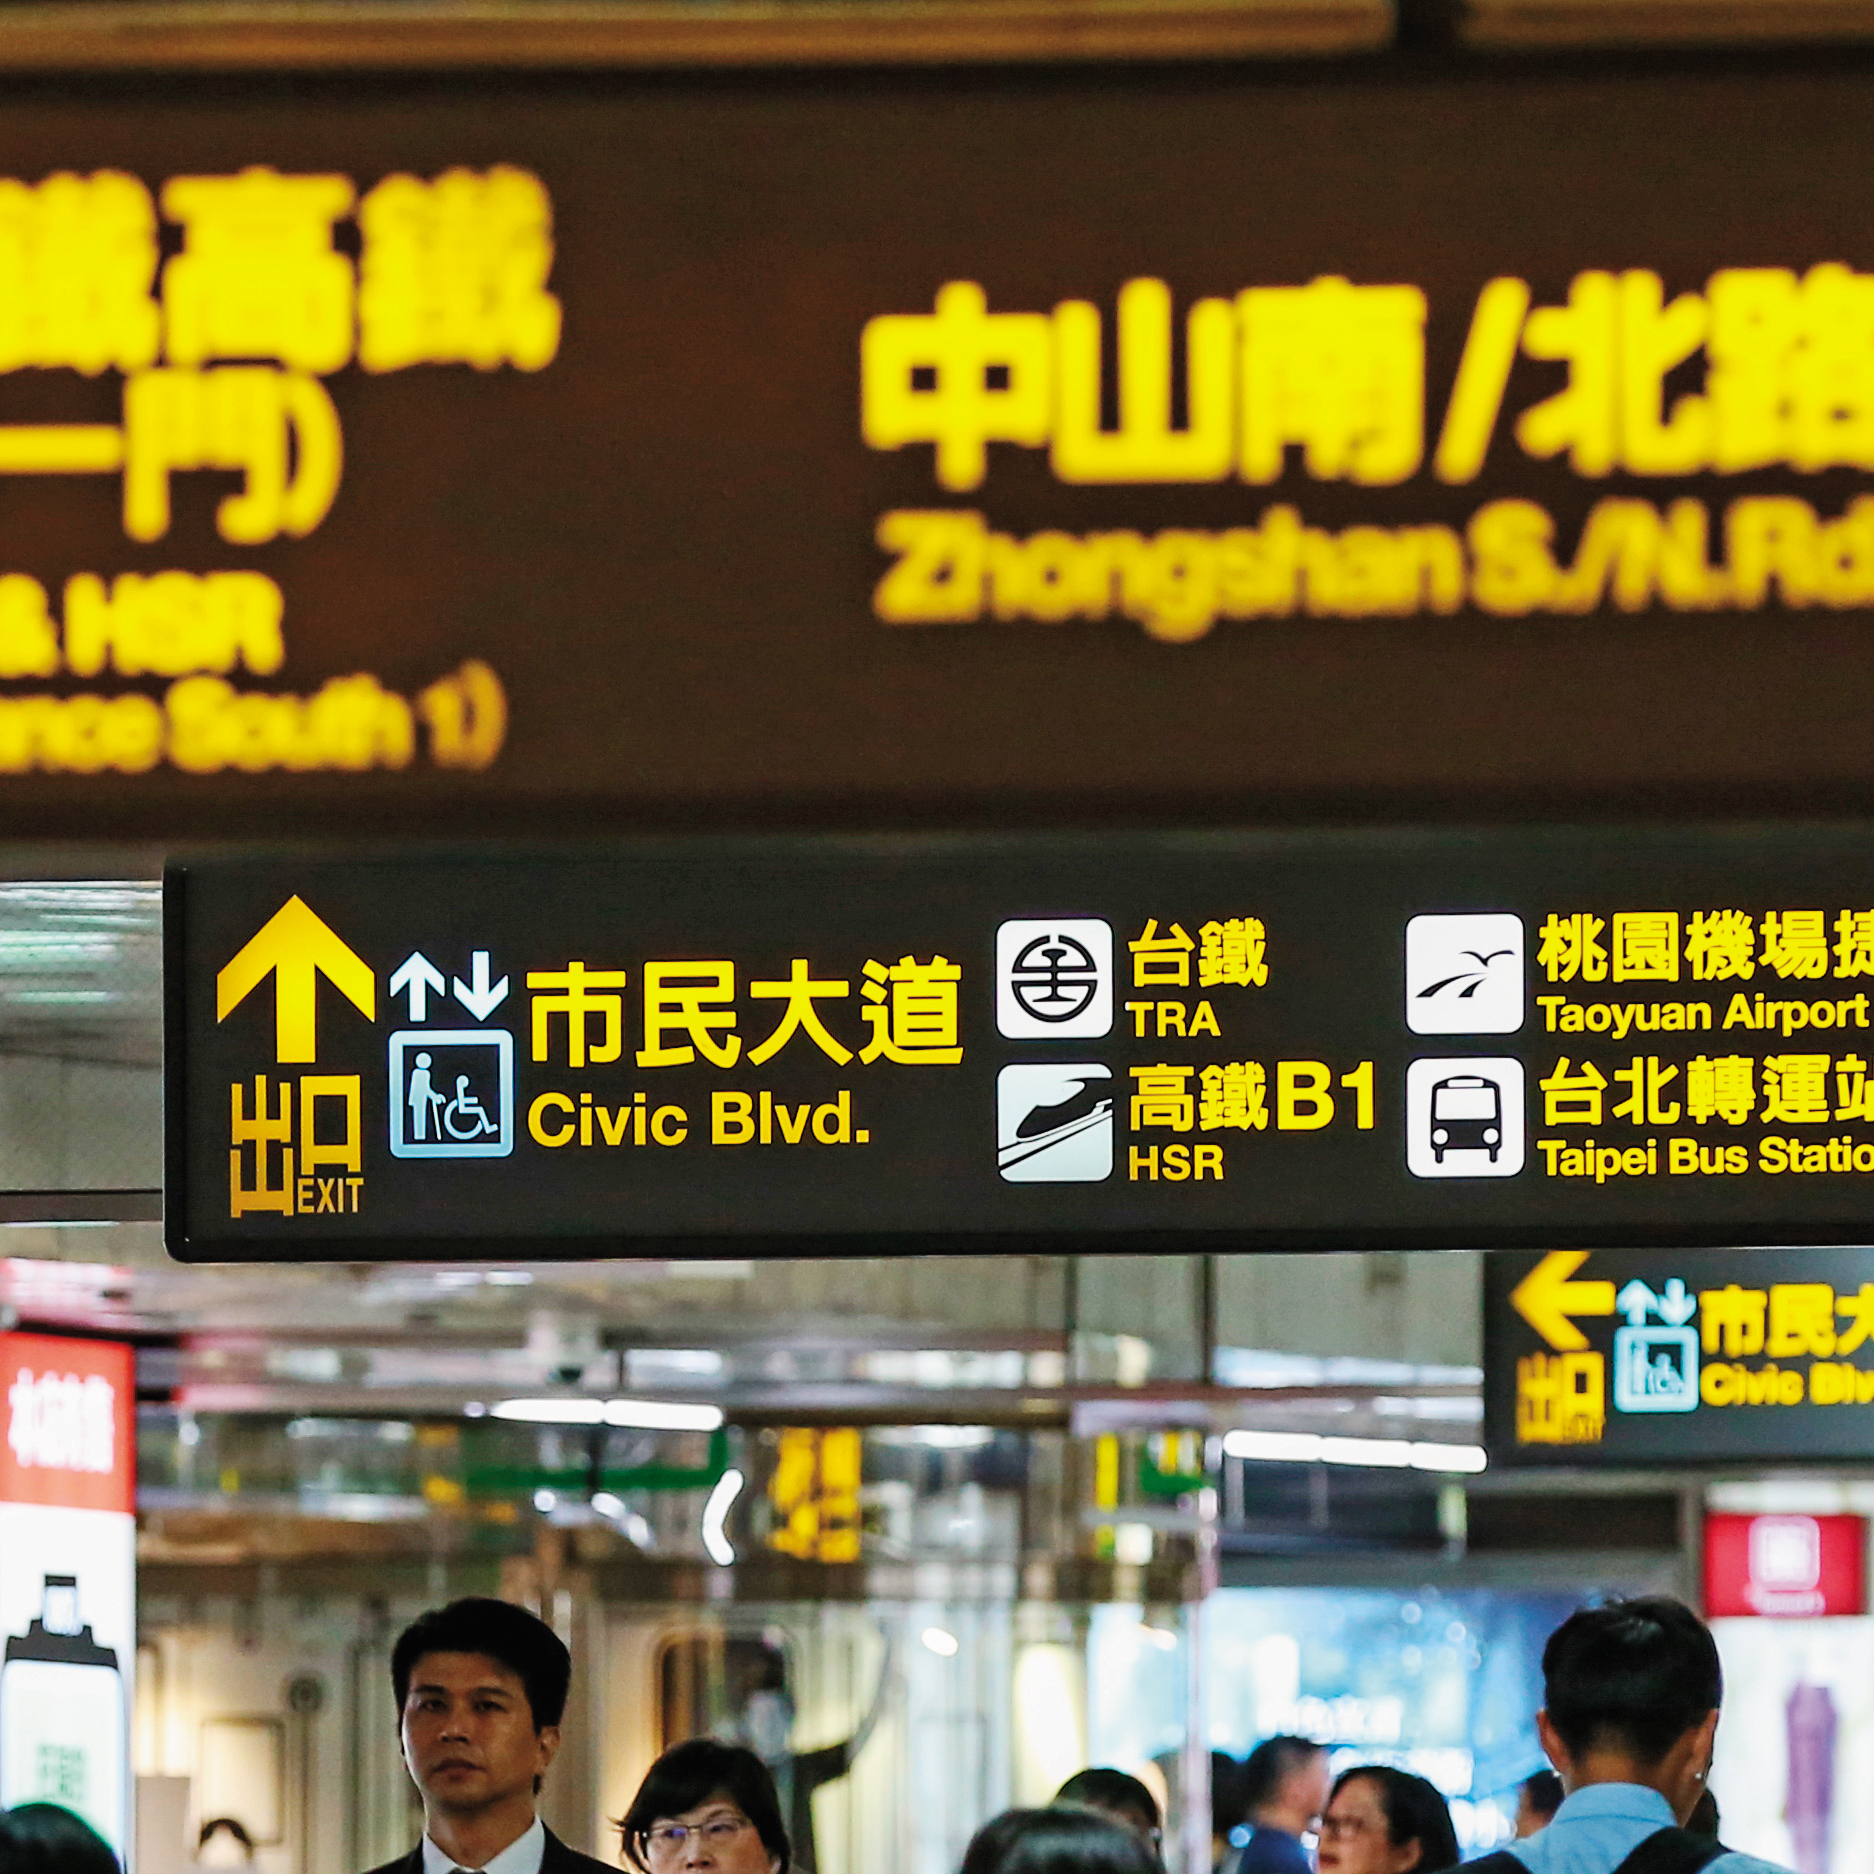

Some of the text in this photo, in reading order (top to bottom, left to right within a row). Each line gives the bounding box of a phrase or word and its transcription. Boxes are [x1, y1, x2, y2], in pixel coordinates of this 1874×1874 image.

[873, 503, 1466, 642] Zhongshan
[62, 569, 285, 678] HSR
[1127, 916, 1269, 988] 台鐵
[526, 954, 965, 1069] 市民大道
[1125, 1000, 1222, 1038] TRA
[1536, 995, 1712, 1040] Taoyuan
[1721, 993, 1870, 1038] Airport
[527, 1090, 870, 1147] Civic Blvd.
[1128, 1060, 1375, 1132] 高鐵B1
[229, 1074, 362, 1219] 出口
[1128, 1143, 1225, 1181] HSR
[1536, 1139, 1657, 1183] Taipei
[1668, 1137, 1749, 1176] Bus
[297, 1177, 364, 1215] EXIT
[1515, 1351, 1607, 1445] 出口
[1699, 1361, 1805, 1406] Civic
